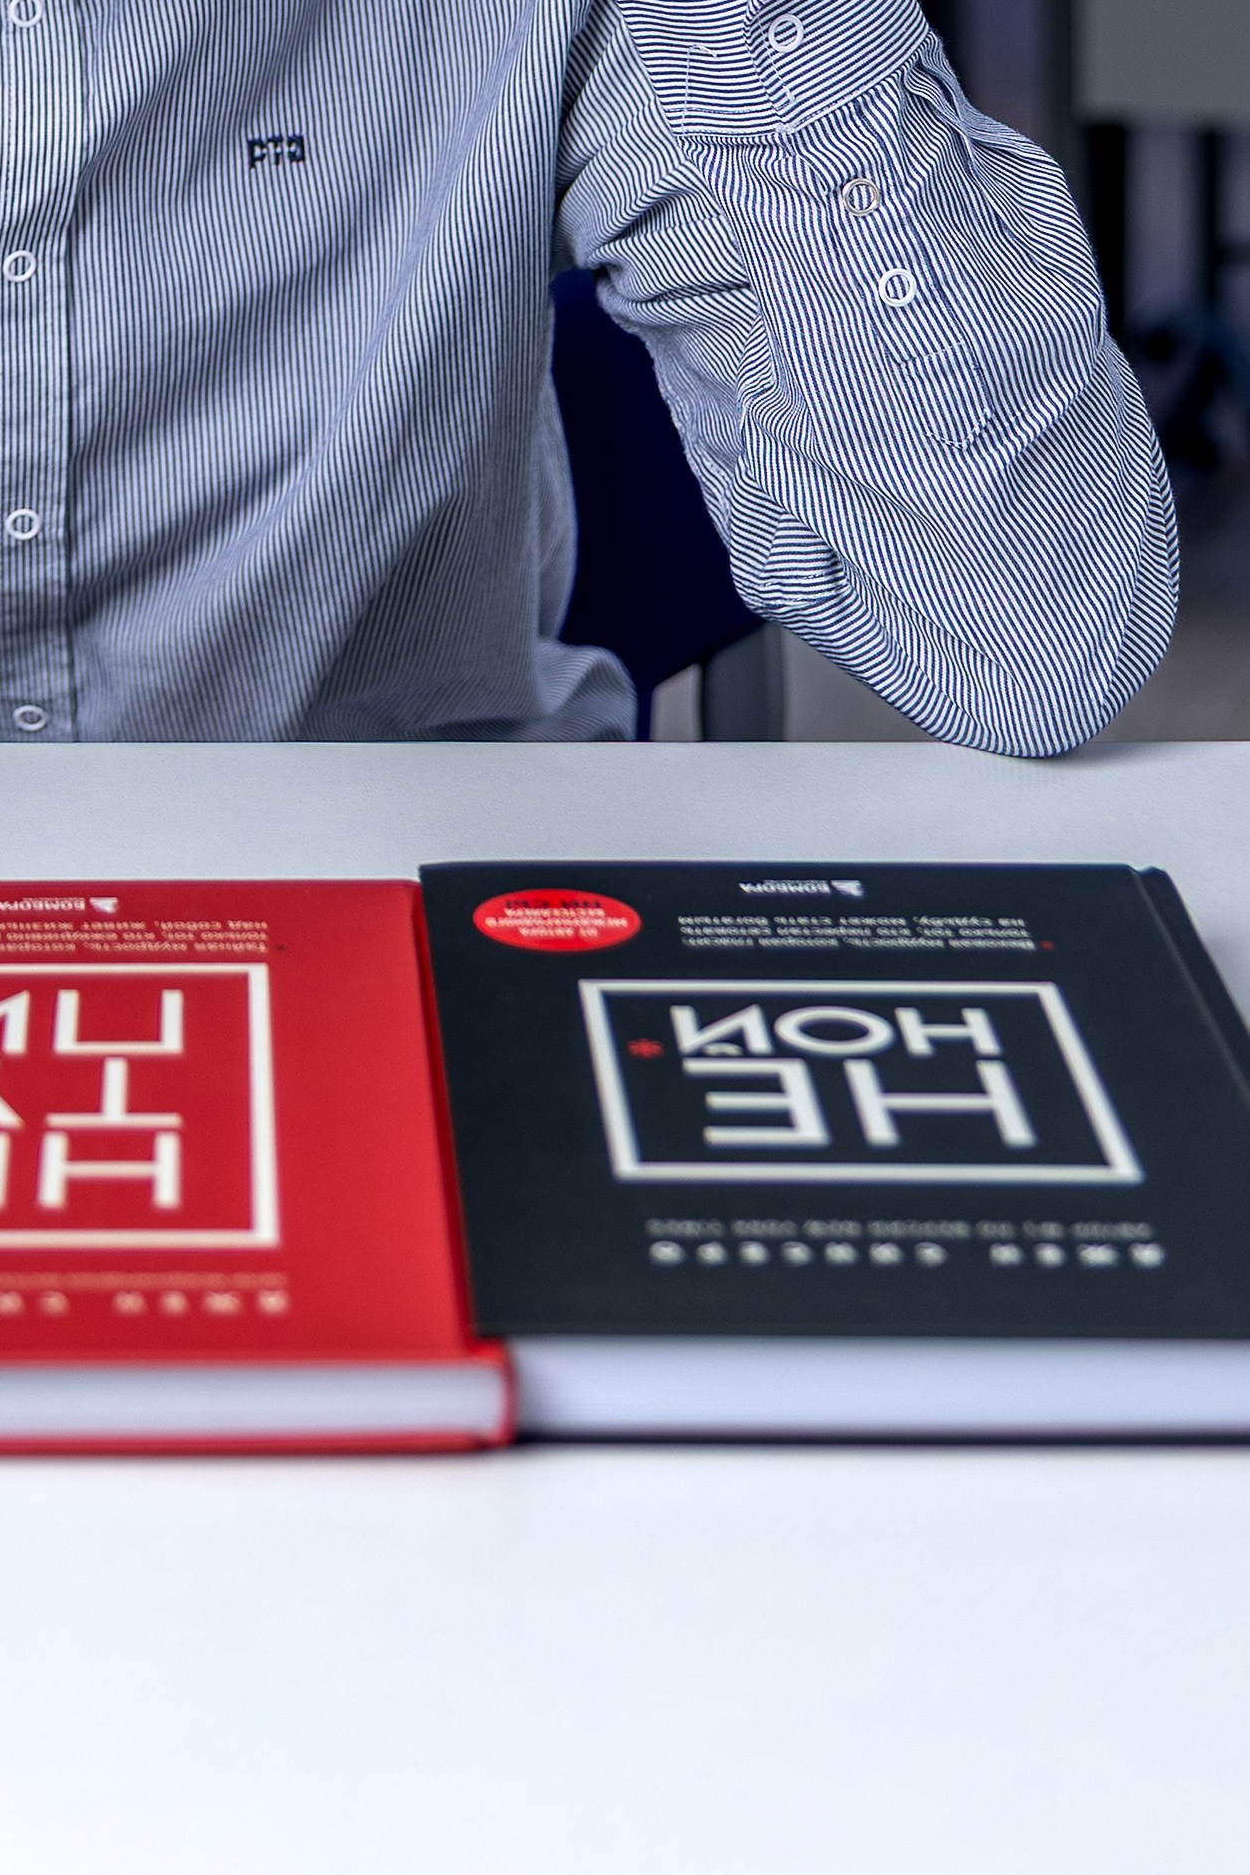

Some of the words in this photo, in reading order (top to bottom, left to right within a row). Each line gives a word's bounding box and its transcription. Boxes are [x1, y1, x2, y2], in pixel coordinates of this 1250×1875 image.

[739, 882, 830, 895] БОМБОРА
[669, 1005, 1004, 1057] НОЙ
[681, 1059, 1036, 1148] НЕ
